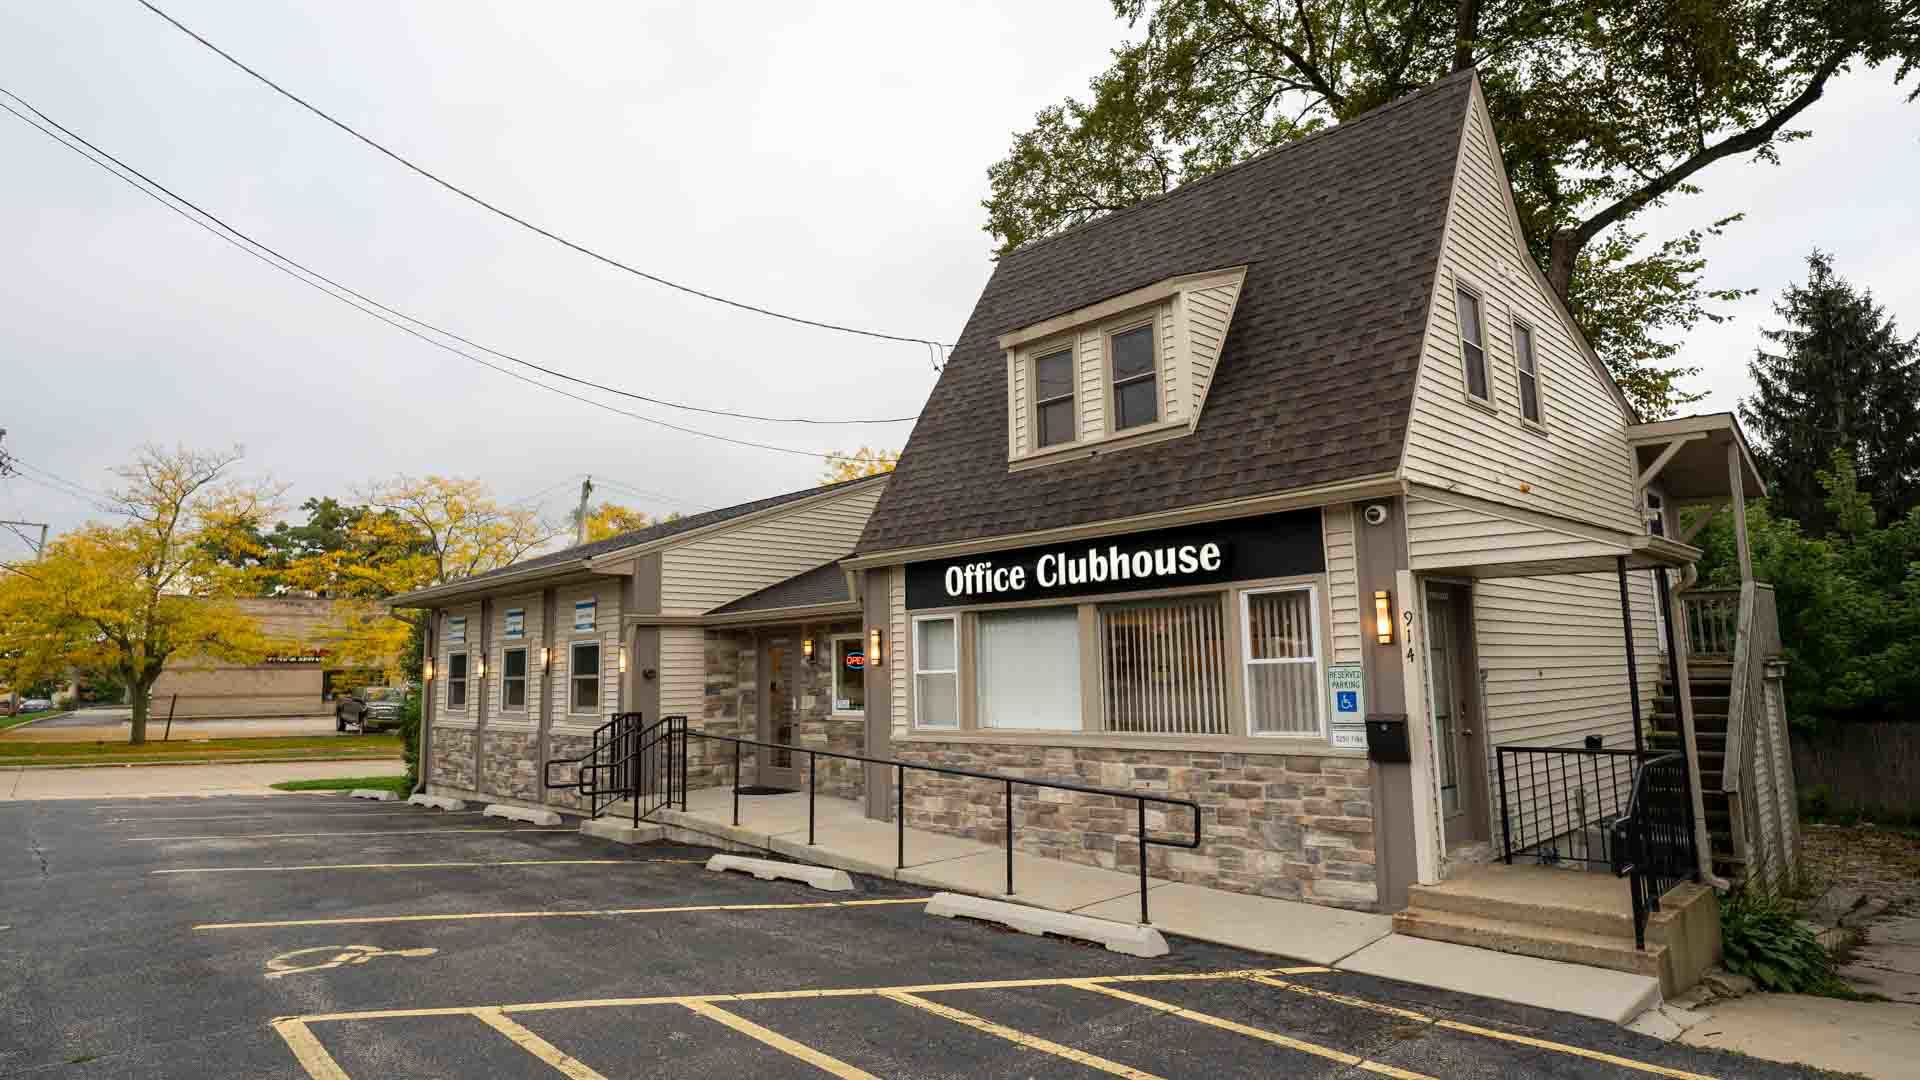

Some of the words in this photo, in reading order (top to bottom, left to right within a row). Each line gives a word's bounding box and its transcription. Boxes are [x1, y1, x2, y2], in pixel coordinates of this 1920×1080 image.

[945, 562, 1025, 596] Office
[1036, 542, 1221, 587] Clubhouse
[1403, 610, 1415, 663] 914
[1329, 671, 1360, 679] RESERVED
[1332, 680, 1360, 689] PARKING
